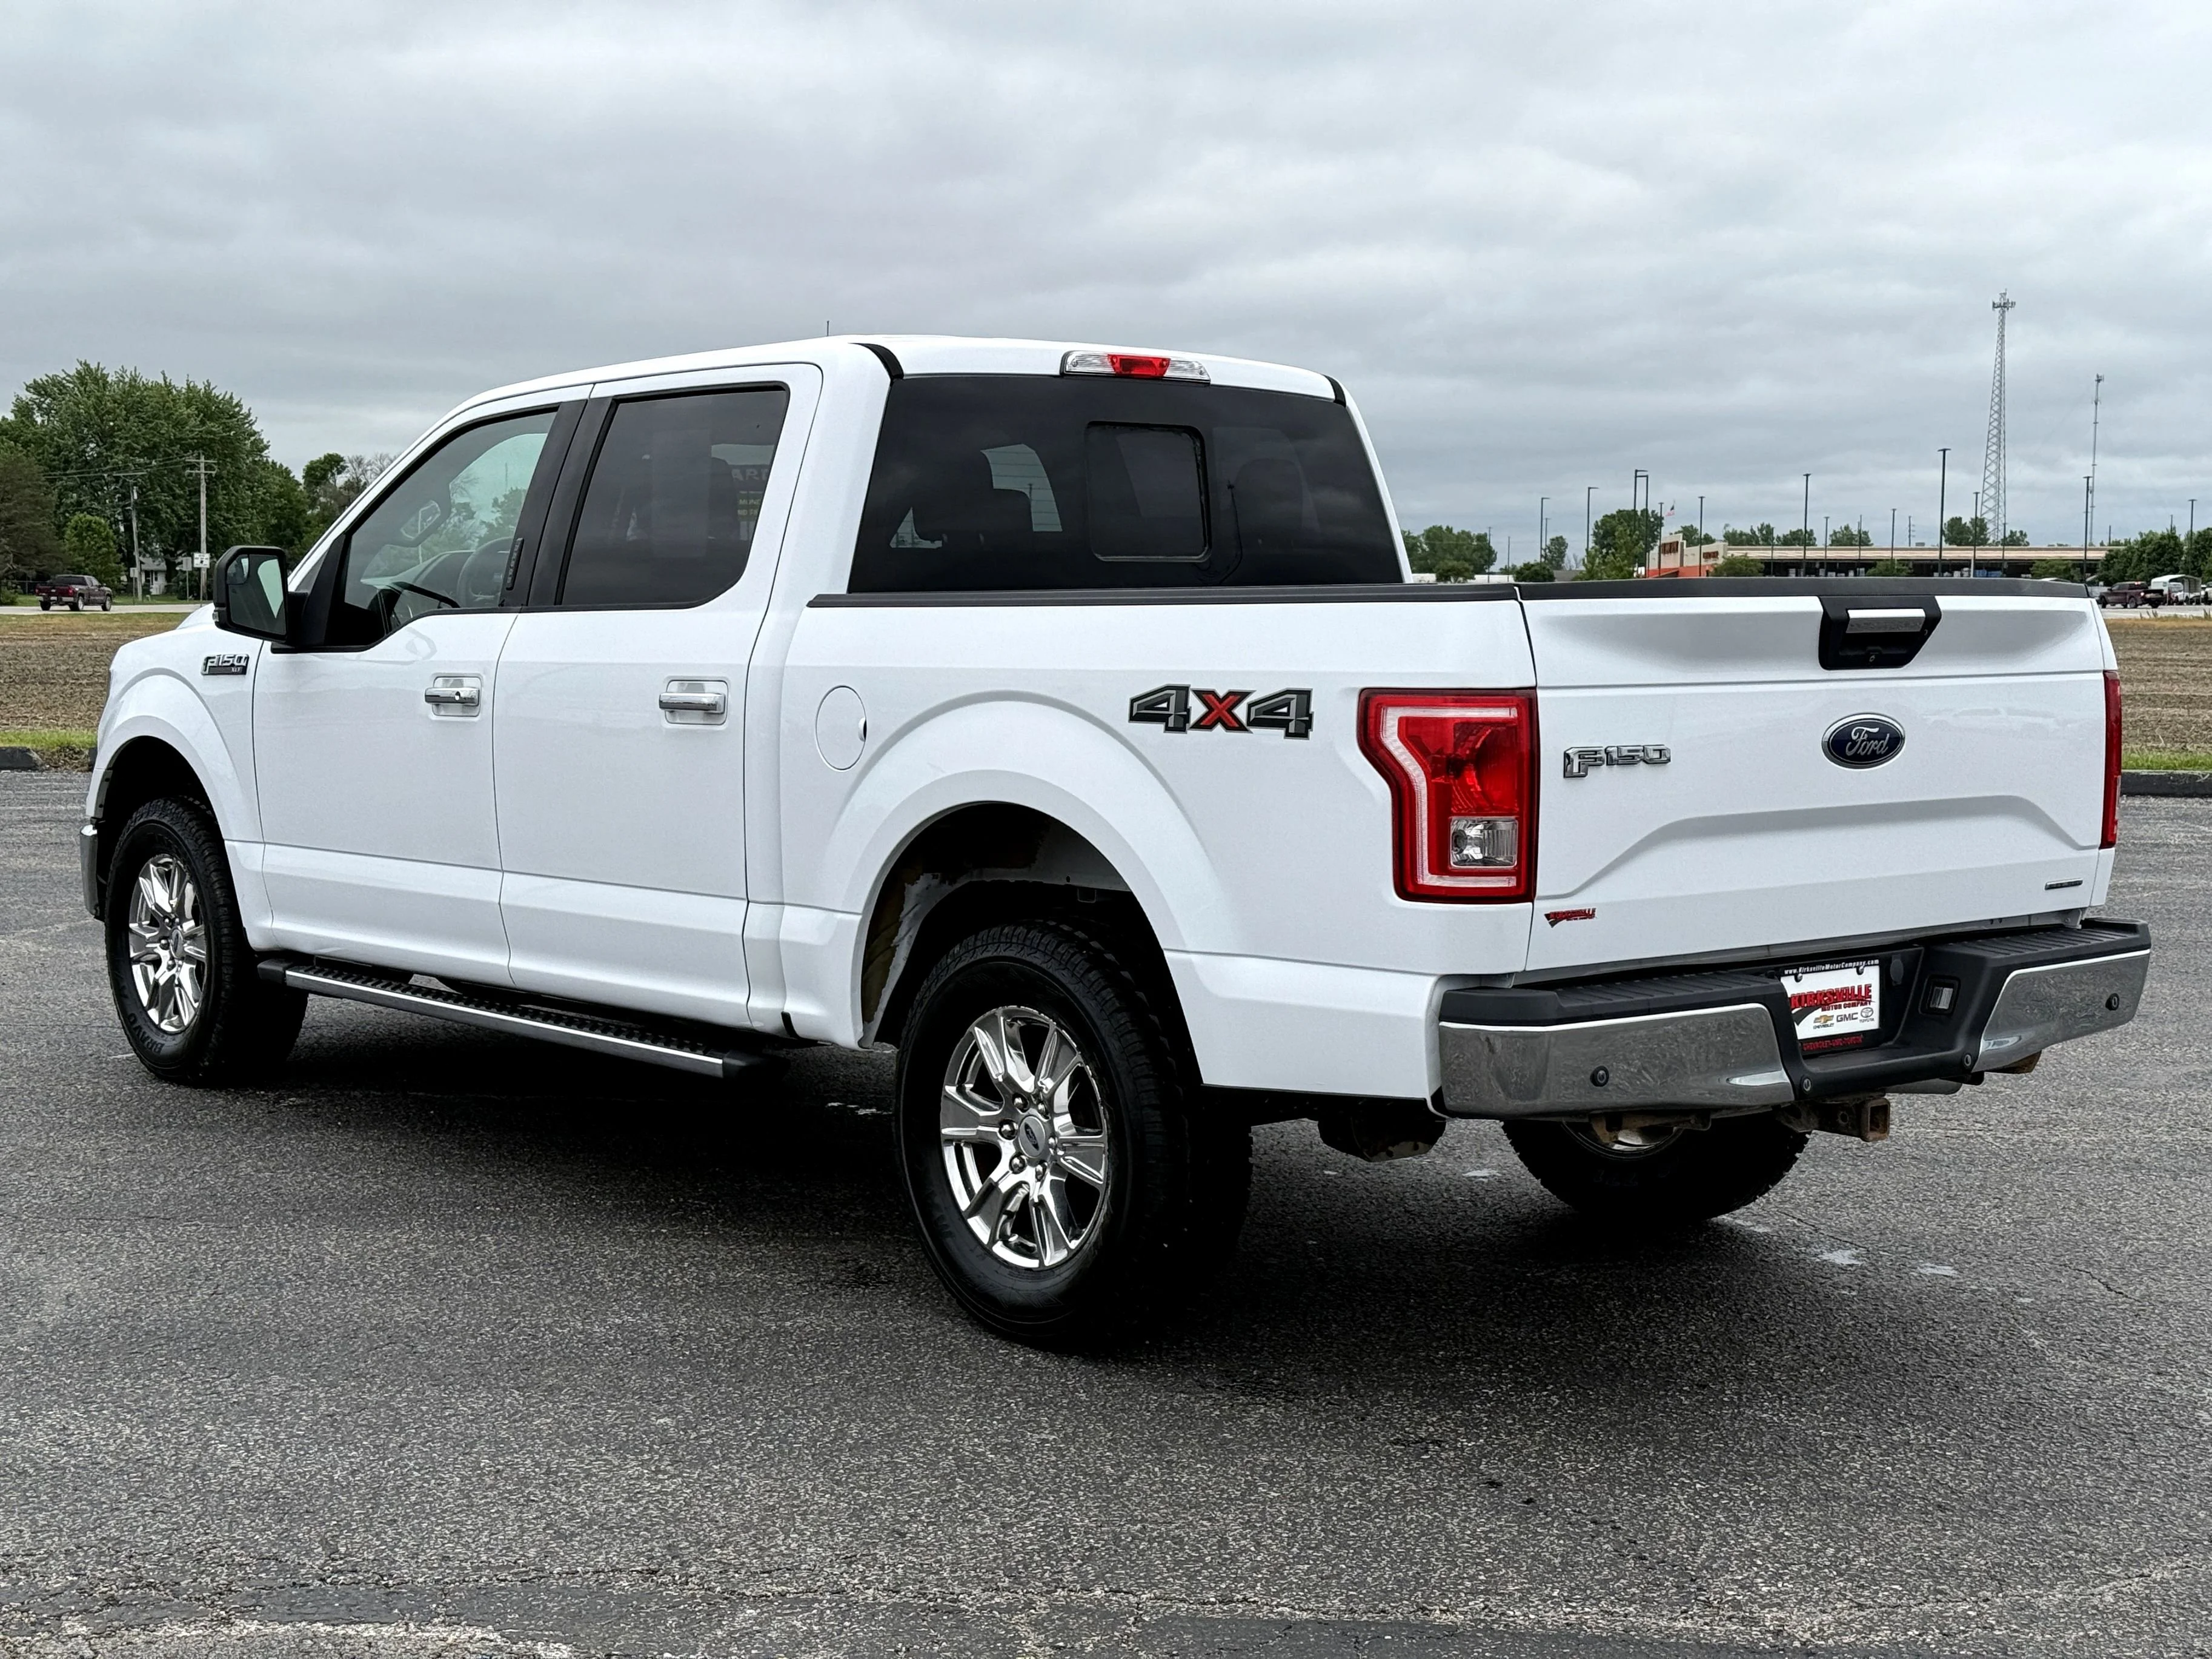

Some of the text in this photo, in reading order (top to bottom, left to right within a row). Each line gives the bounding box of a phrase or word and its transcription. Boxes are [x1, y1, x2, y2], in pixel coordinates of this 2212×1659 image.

[1845, 726, 1890, 756] Ford
[1789, 984, 1872, 1009] KIRKSVILLE
[1843, 1000, 1872, 1009] COMPANY
[1836, 1012, 1859, 1023] GMC
